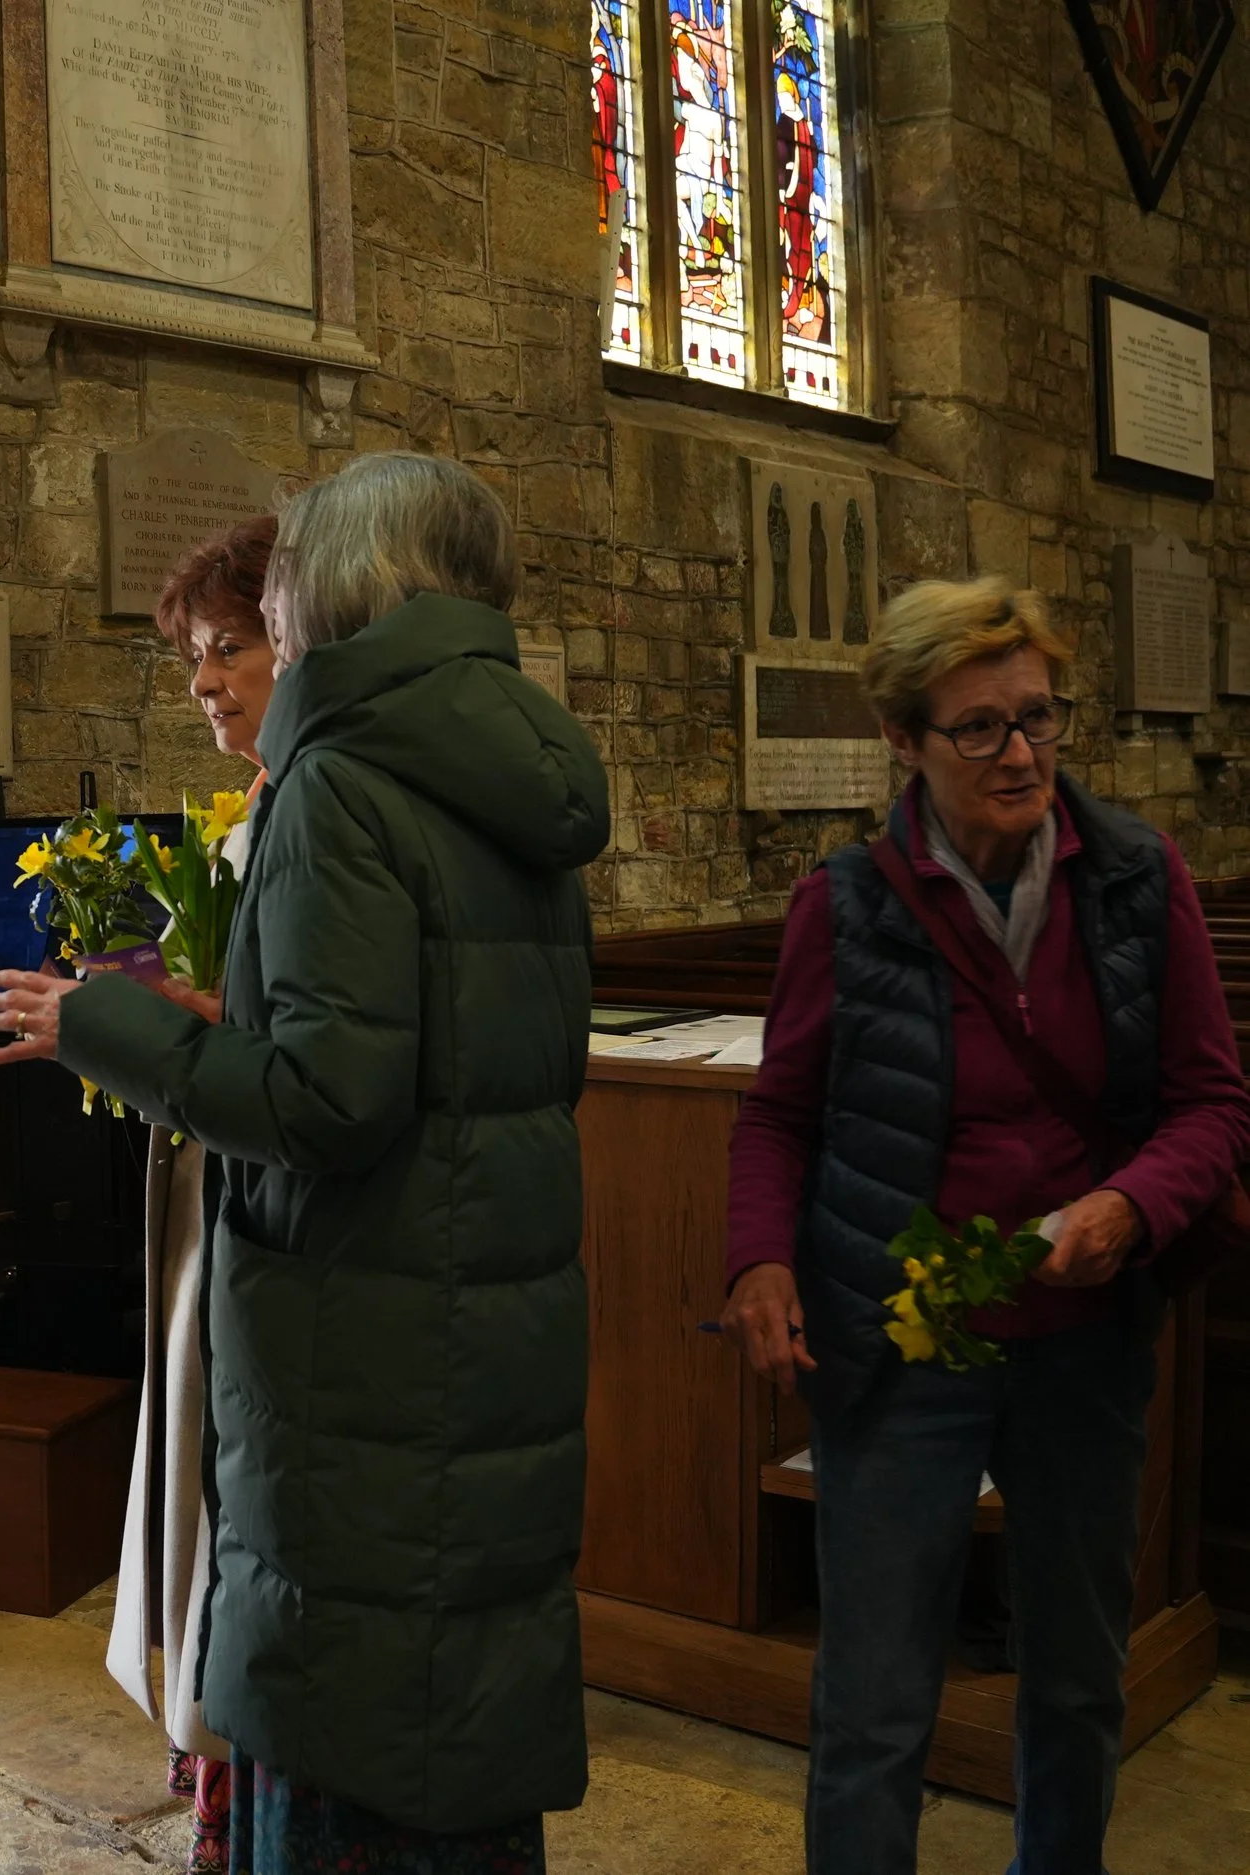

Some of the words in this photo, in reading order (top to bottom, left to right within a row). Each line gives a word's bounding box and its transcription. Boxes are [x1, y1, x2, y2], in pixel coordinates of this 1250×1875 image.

[141, 23, 159, 40] Day
[227, 76, 242, 88] HIS
[94, 176, 111, 192] The
[114, 182, 141, 198] Stroke
[108, 209, 126, 223] And
[129, 213, 143, 227] the
[148, 476, 159, 486] TO
[166, 478, 182, 488] THE
[188, 481, 215, 492] GLORY
[219, 485, 230, 494] OF
[232, 486, 249, 496] GOD
[123, 490, 140, 501] AND
[144, 492, 152, 501] IN
[158, 494, 198, 507] THANKFUL
[202, 499, 258, 514] REMEMBRANCE
[121, 509, 168, 523] CHARLES
[174, 514, 229, 529] PENBERTHY
[135, 530, 186, 544] CHORISTER,
[125, 546, 172, 560] PAROCHIAL
[120, 564, 163, 575] HONORARY
[121, 580, 146, 591] BORN
